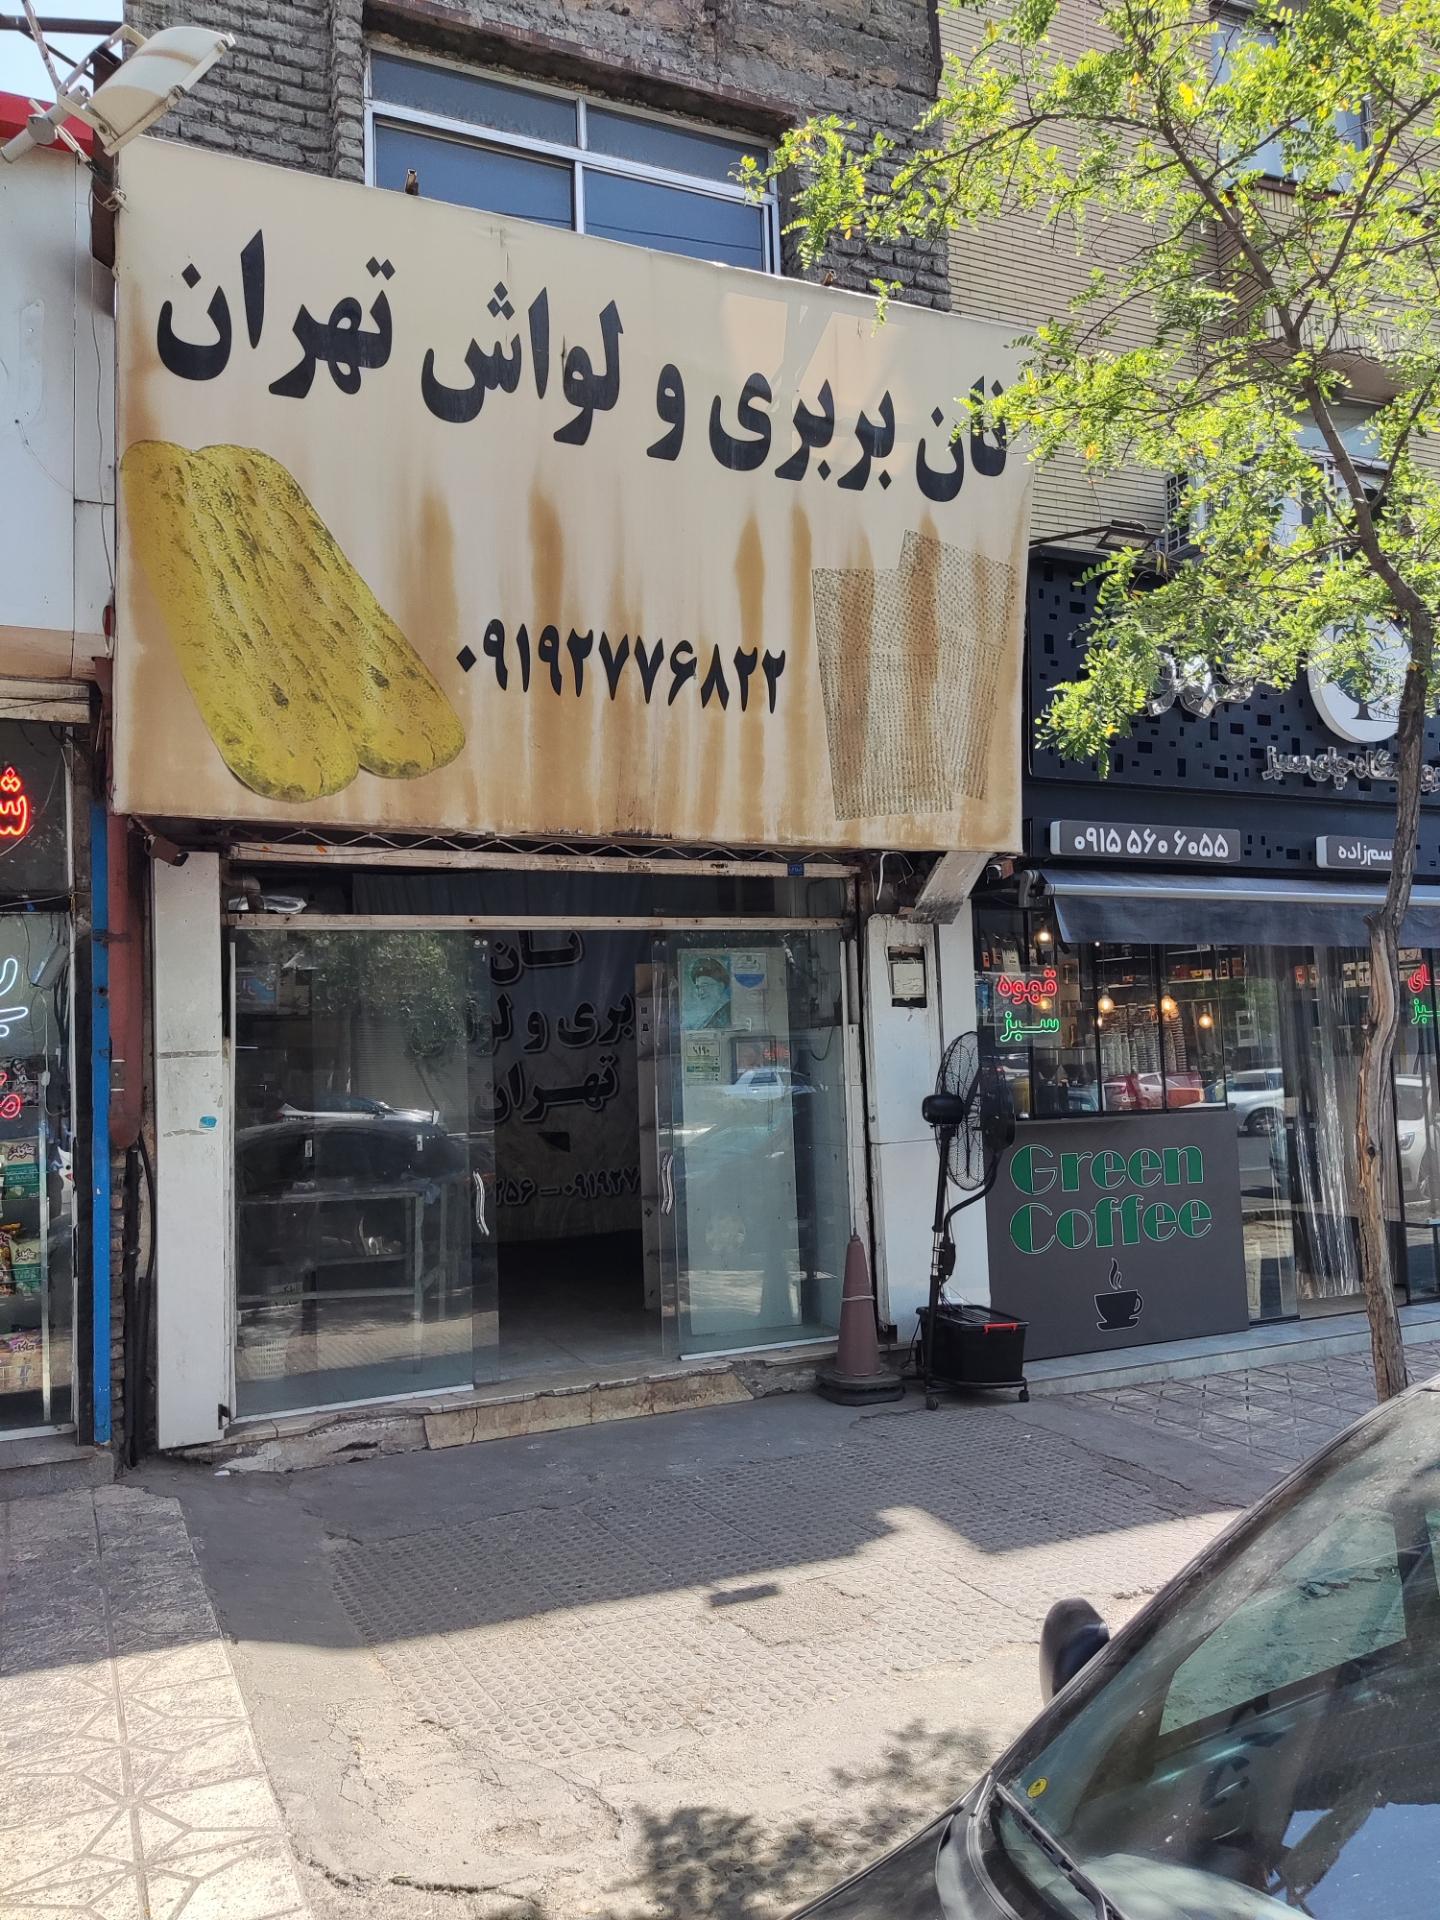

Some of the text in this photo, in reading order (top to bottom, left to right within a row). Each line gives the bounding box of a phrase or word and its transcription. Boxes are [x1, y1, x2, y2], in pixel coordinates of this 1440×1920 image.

[156, 229, 1007, 502] نان بربری و لواش تهران
[456, 619, 786, 714] ۰۹۱۹۲۷۷۶۸۲۲
[1262, 745, 1311, 780] سبز
[998, 969, 1058, 1006] قهوه
[1000, 1011, 1060, 1042] سبز
[474, 1053, 620, 1123] تهران
[1010, 1143, 1204, 1195] Green
[1009, 1193, 1213, 1255] Coffee
